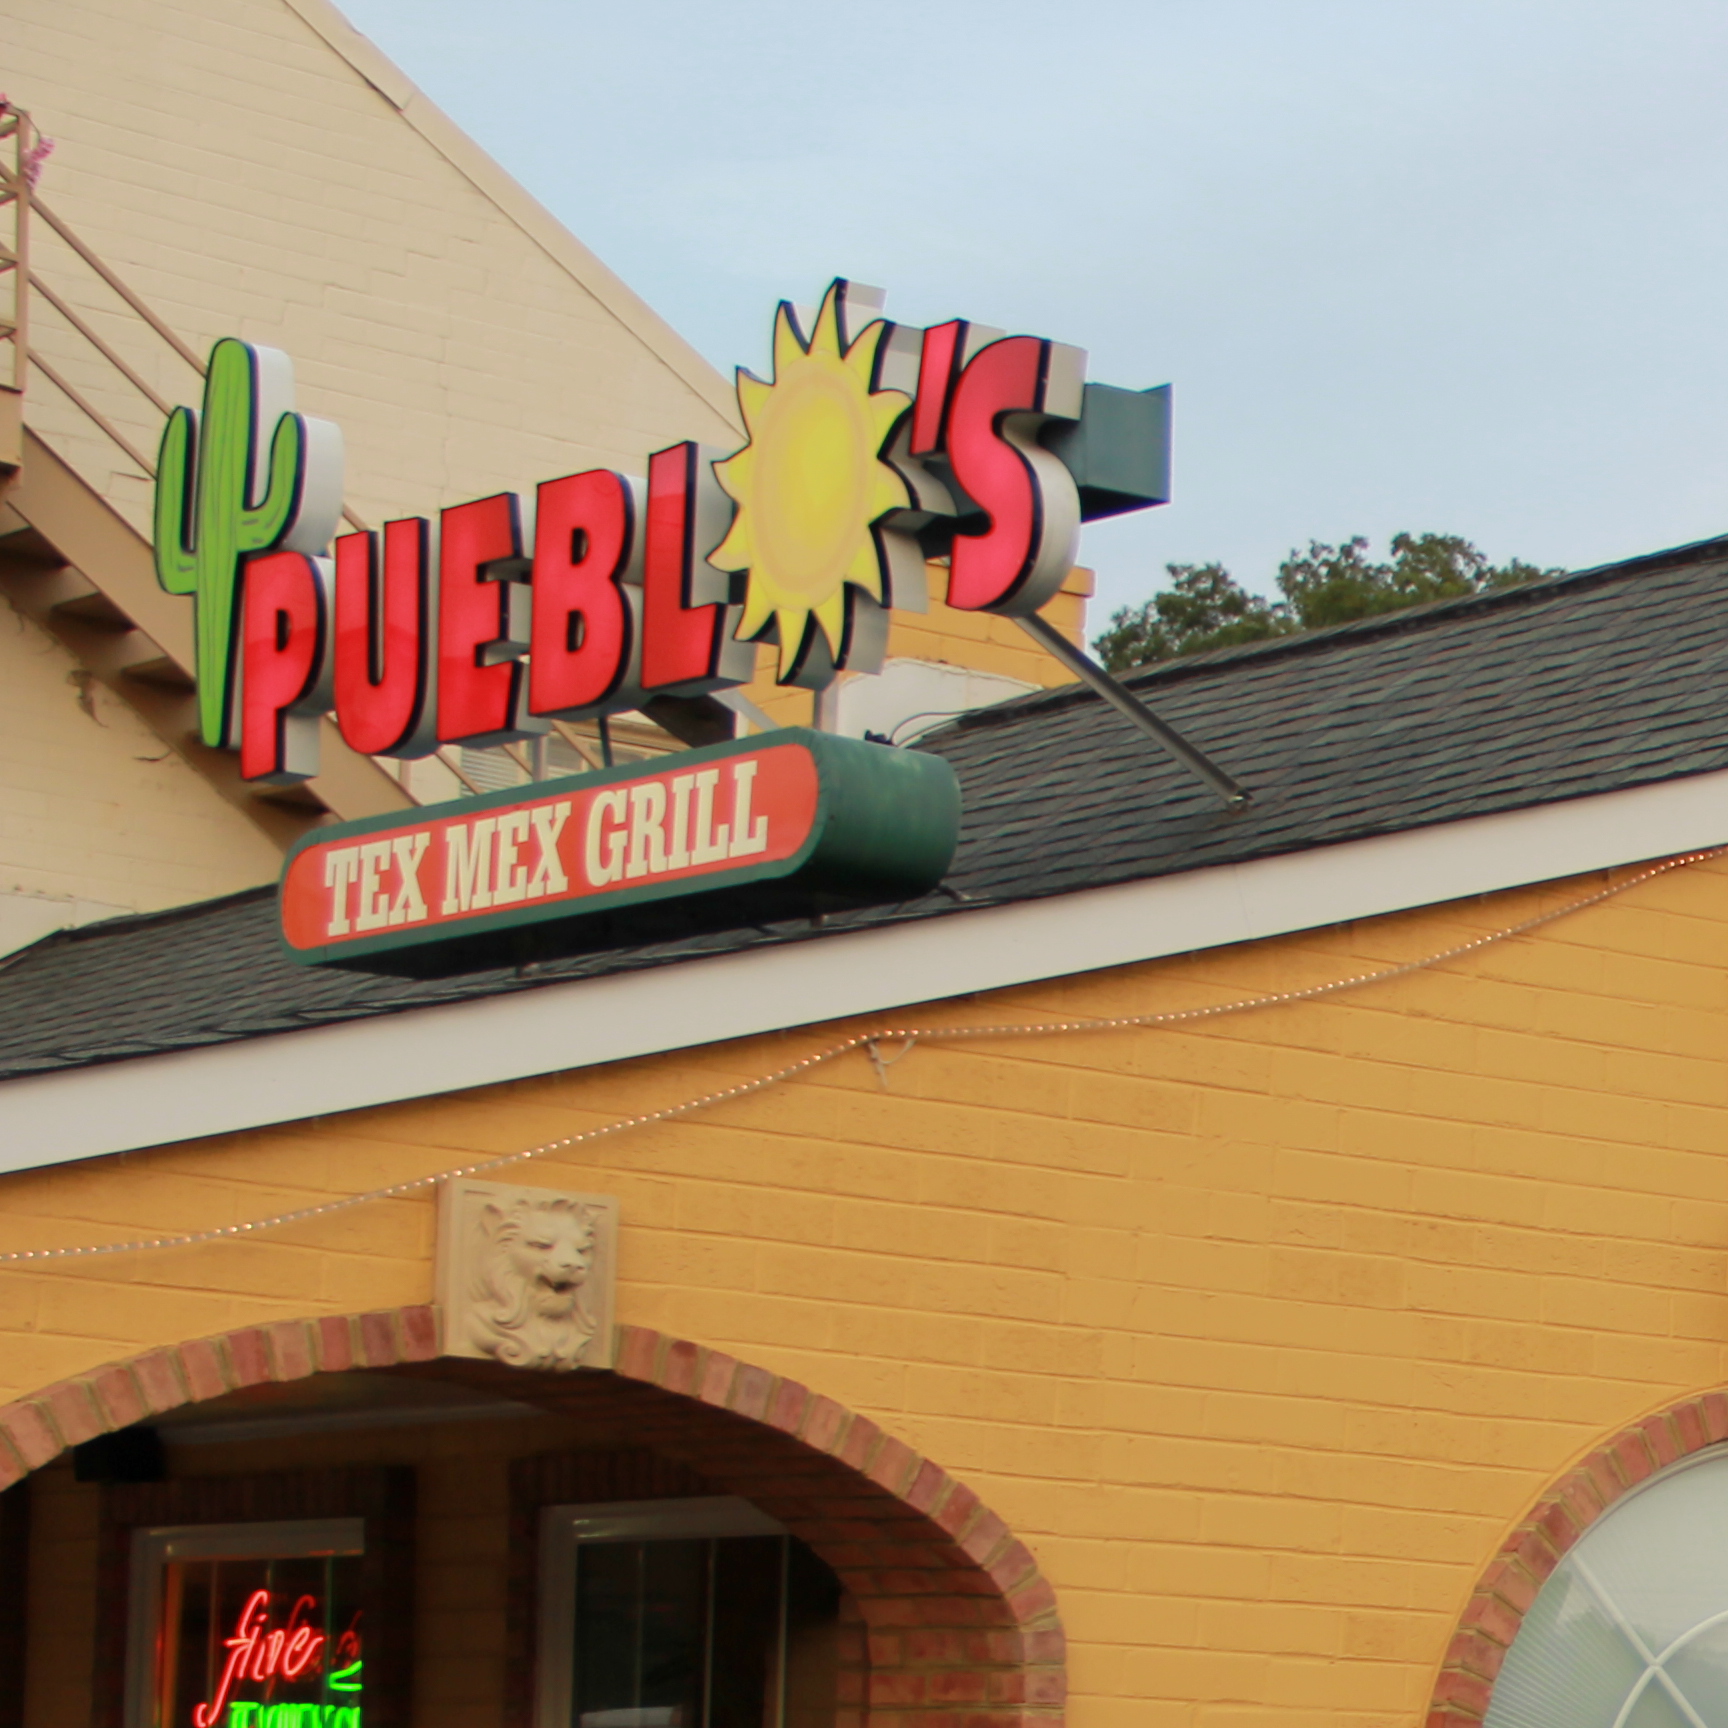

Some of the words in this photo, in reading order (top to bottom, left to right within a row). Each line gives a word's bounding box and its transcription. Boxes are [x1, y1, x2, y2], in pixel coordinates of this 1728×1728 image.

[325, 832, 430, 937] TEX
[442, 802, 572, 916] MEX
[585, 761, 768, 887] GRILL
[194, 1589, 325, 1728] fine
